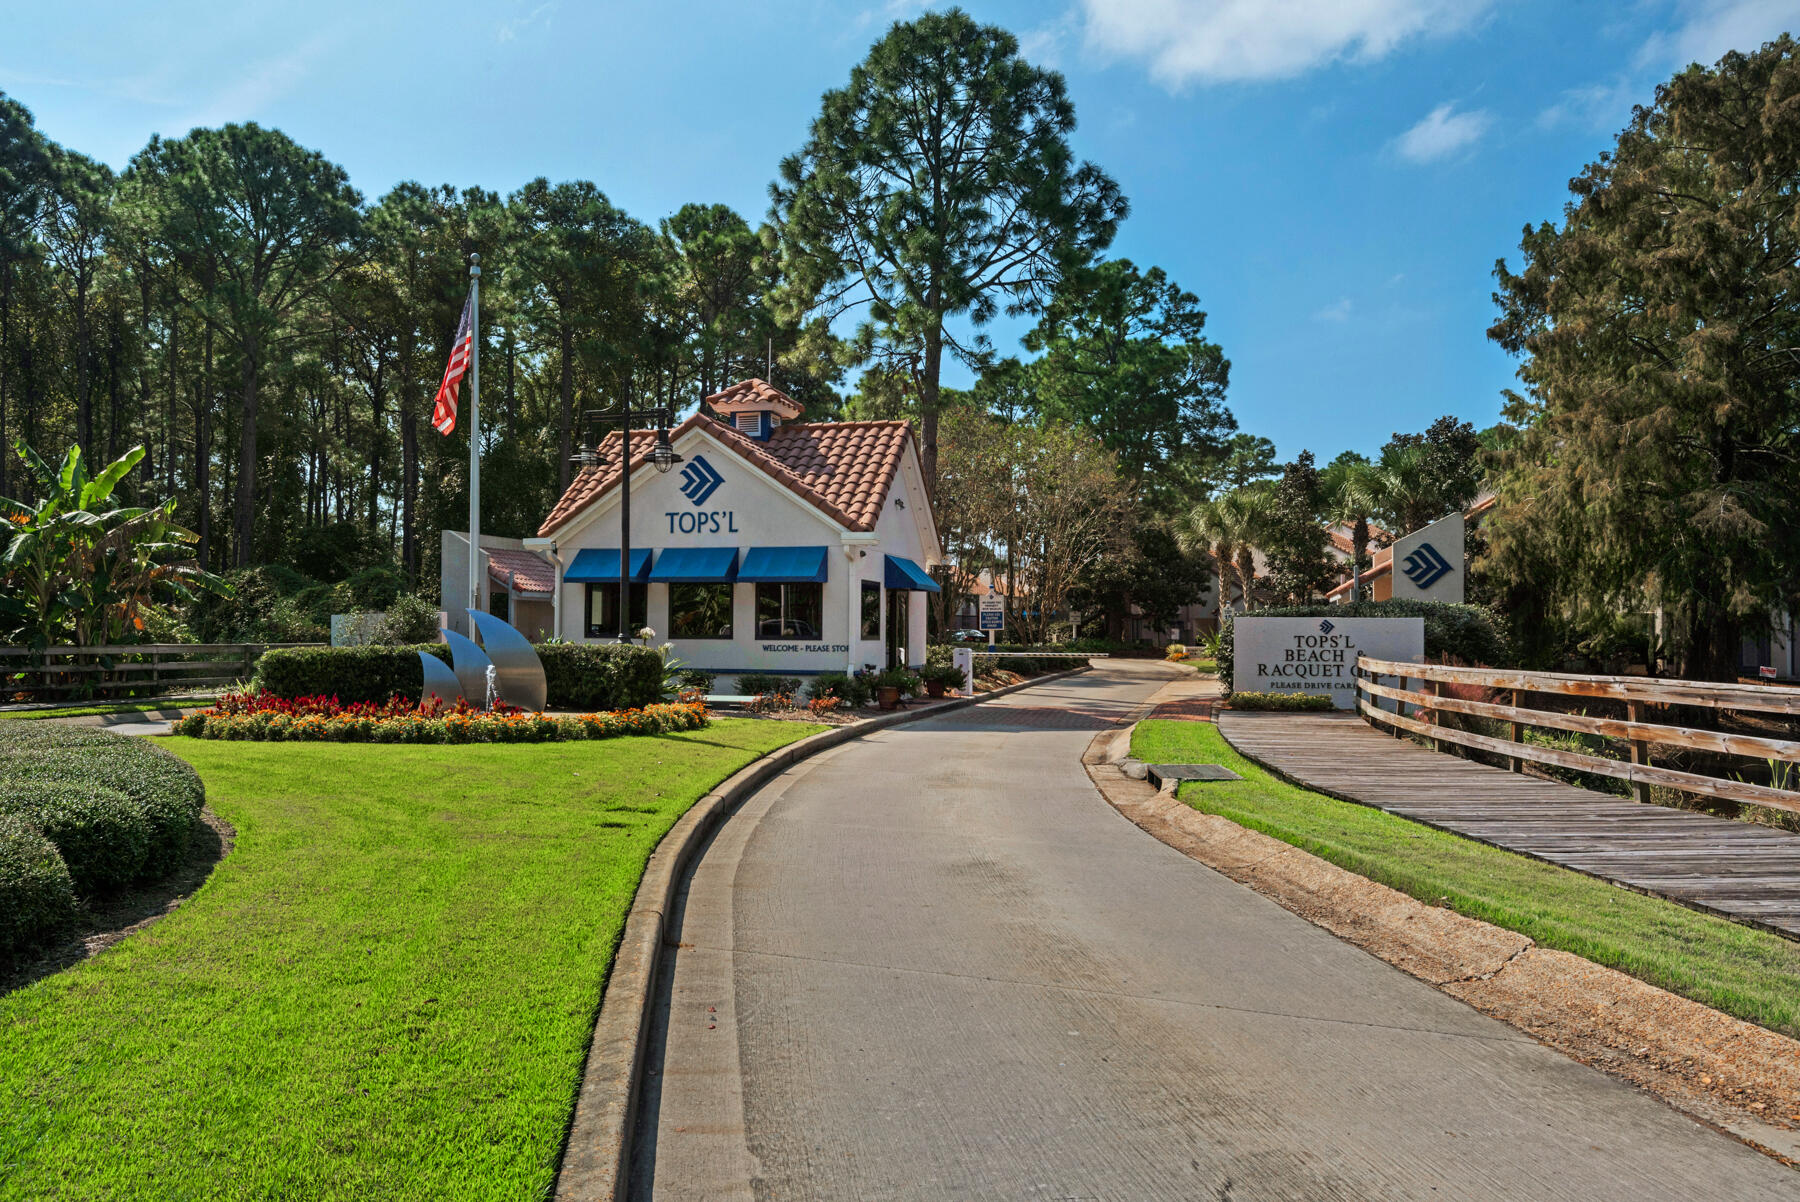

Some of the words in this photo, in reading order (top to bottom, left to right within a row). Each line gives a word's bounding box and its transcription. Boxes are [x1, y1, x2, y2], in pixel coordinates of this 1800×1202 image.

[762, 644, 799, 652] WELCOME
[805, 644, 830, 652] PLEASE
[1285, 649, 1344, 662] BEACH
[1257, 663, 1344, 679] RACQUET
